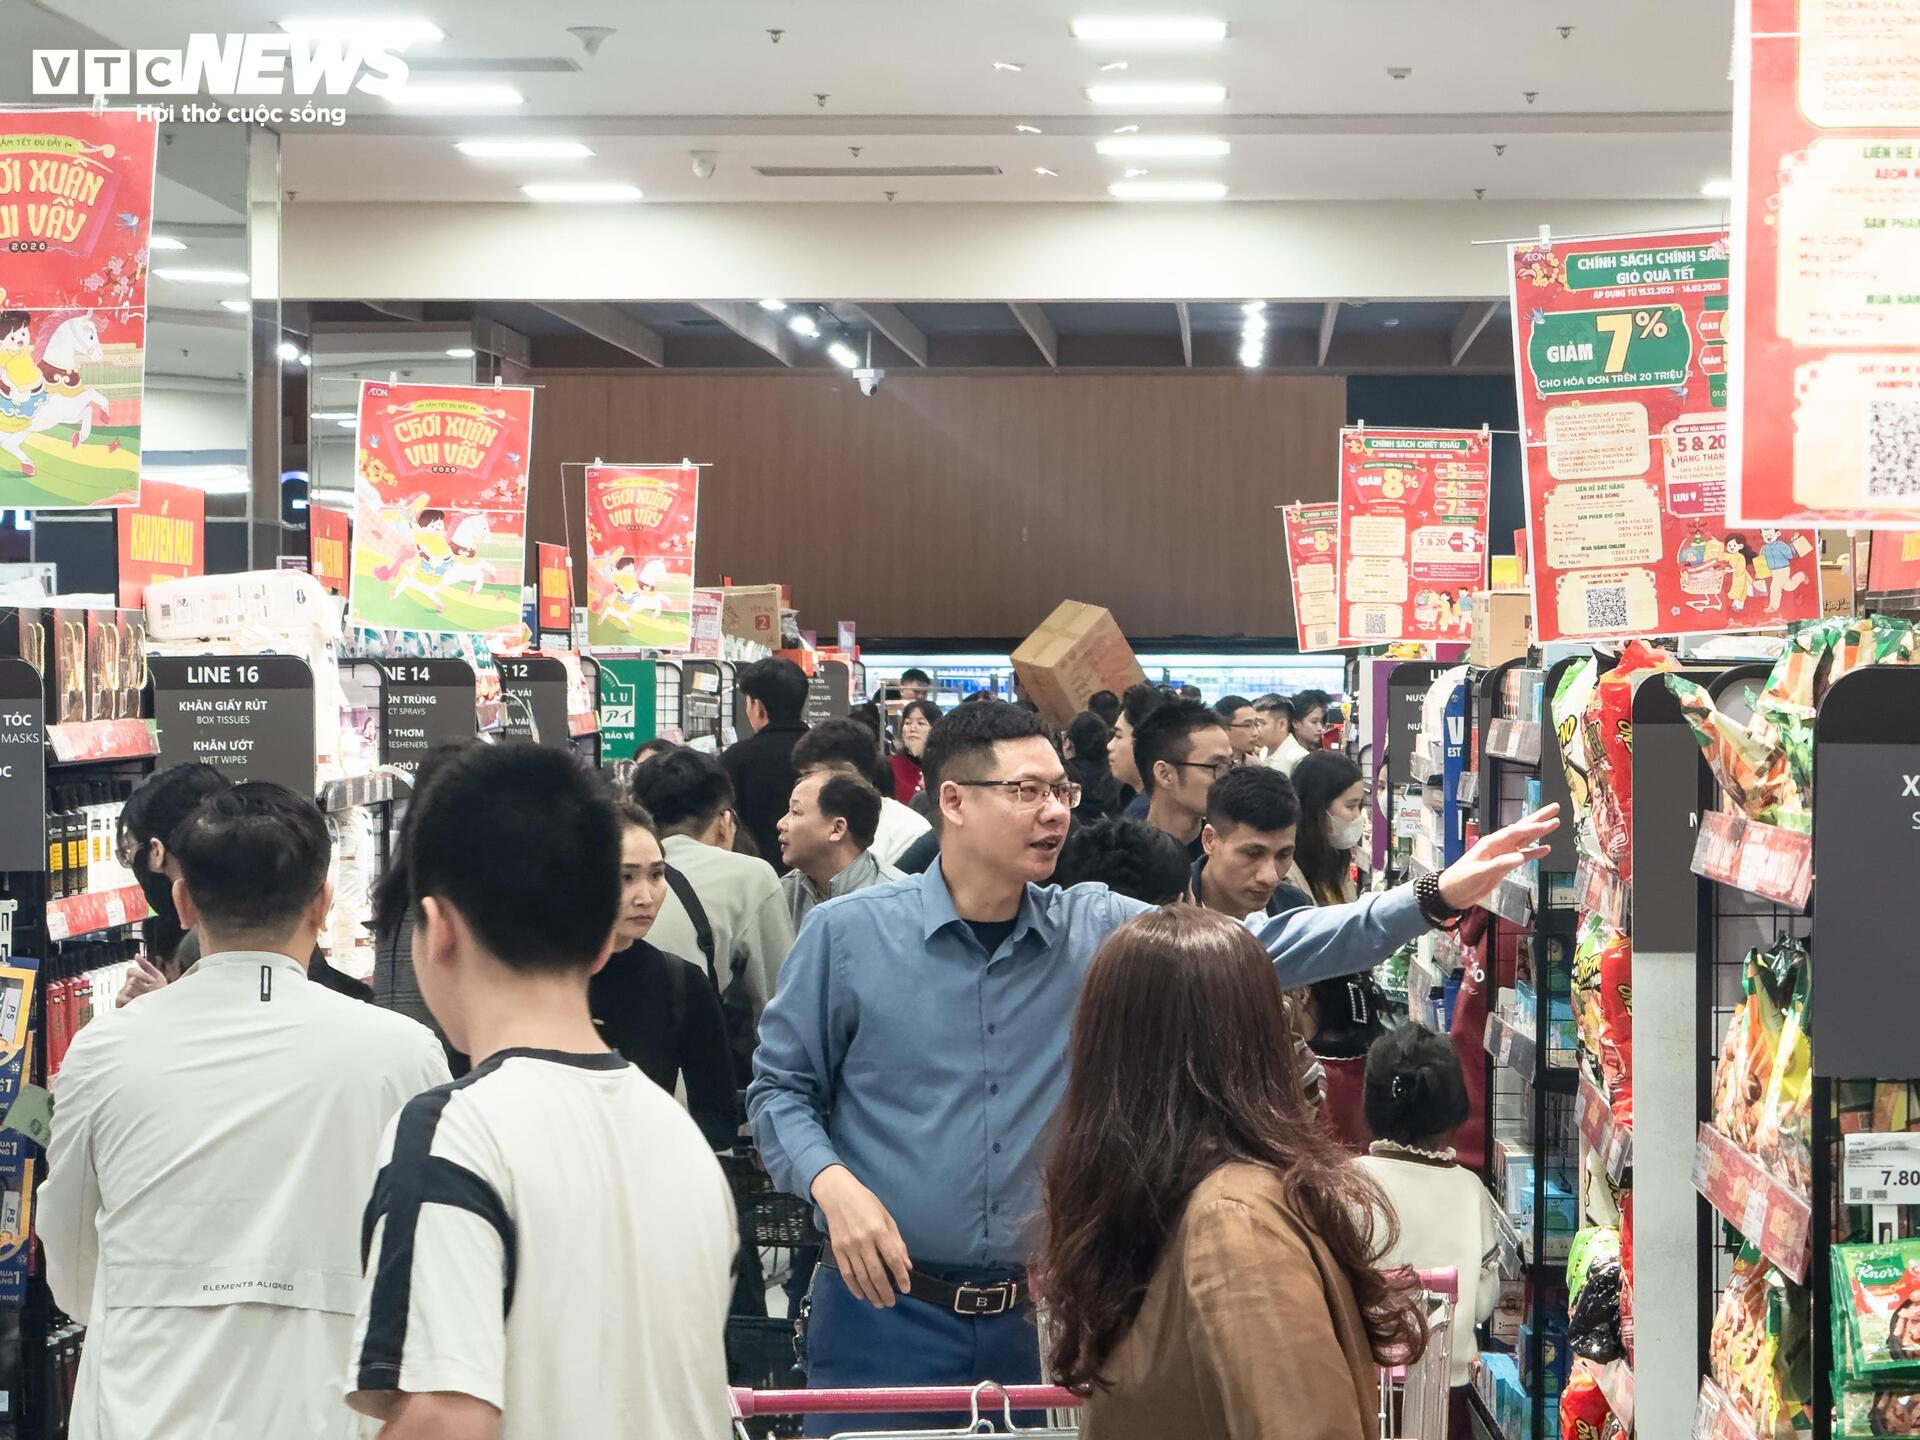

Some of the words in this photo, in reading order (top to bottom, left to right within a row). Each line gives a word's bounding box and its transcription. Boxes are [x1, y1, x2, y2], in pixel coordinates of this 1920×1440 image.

[29, 157, 105, 206] XUÂN
[27, 197, 87, 243] VẦY
[10, 242, 47, 252] 2026
[1577, 255, 1617, 270] CHÍNH
[1620, 253, 1653, 268] SÁCH
[1655, 250, 1696, 267] CHÍNH
[1616, 269, 1641, 284] GIỎ
[1674, 265, 1695, 280] TẾT
[1547, 341, 1593, 363] GIẢM
[1539, 379, 1561, 388] CHO
[1564, 376, 1585, 387] HÓA
[1587, 375, 1609, 385] ĐƠN
[1612, 373, 1637, 383] TRÊN
[1639, 372, 1651, 382] 20
[1654, 369, 1683, 382] TRIỆU
[445, 414, 498, 448] XUÂN
[1677, 437, 1687, 453] 5
[1692, 436, 1704, 451] &
[1708, 434, 1727, 450] 20
[404, 443, 440, 467] VUI
[1357, 474, 1382, 487] GIẢM
[636, 487, 673, 511] XUÂN
[608, 509, 632, 528] VUI
[759, 616, 767, 629] 2
[187, 666, 231, 683] LINE
[236, 665, 259, 683] 16
[411, 666, 430, 681] 14
[512, 664, 528, 677] 12
[179, 699, 212, 711] KHĂN
[215, 698, 241, 711] GIẤY
[245, 698, 268, 710] RÚT
[403, 693, 437, 705] TRÙNG
[3, 711, 32, 726] TÓC
[399, 707, 426, 716] SPRAYS
[197, 716, 214, 724] BOX
[217, 715, 250, 724] TISSUES
[1, 733, 39, 743] MASKS
[394, 728, 424, 738] THƠM
[193, 739, 227, 751] KHĂN
[229, 738, 254, 750] ƯỚT
[200, 755, 218, 764] WET
[220, 755, 247, 764] WIPES
[1447, 747, 1461, 758] EST
[6, 1207, 15, 1224] PS
[1856, 1264, 1903, 1281] Knorr
[203, 1281, 254, 1292] ELEMENTS
[256, 1280, 294, 1291] ALIGNED
[976, 1297, 987, 1308] B
